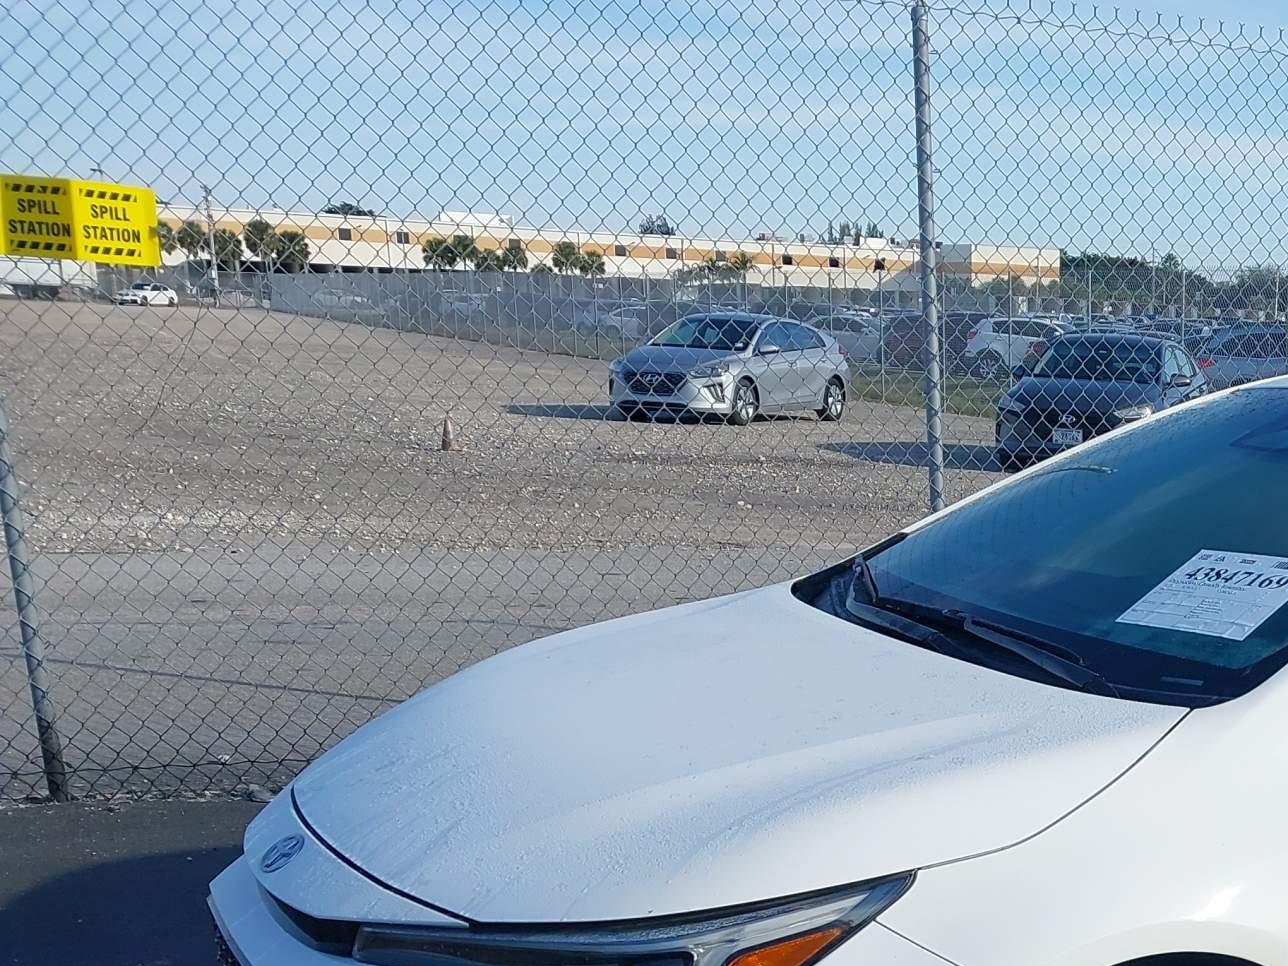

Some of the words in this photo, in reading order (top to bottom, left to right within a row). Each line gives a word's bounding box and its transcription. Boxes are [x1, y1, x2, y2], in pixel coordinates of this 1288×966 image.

[17, 198, 60, 216] SPILL
[90, 203, 131, 222] SPILL
[8, 219, 72, 238] STATION
[82, 224, 142, 244] STATION
